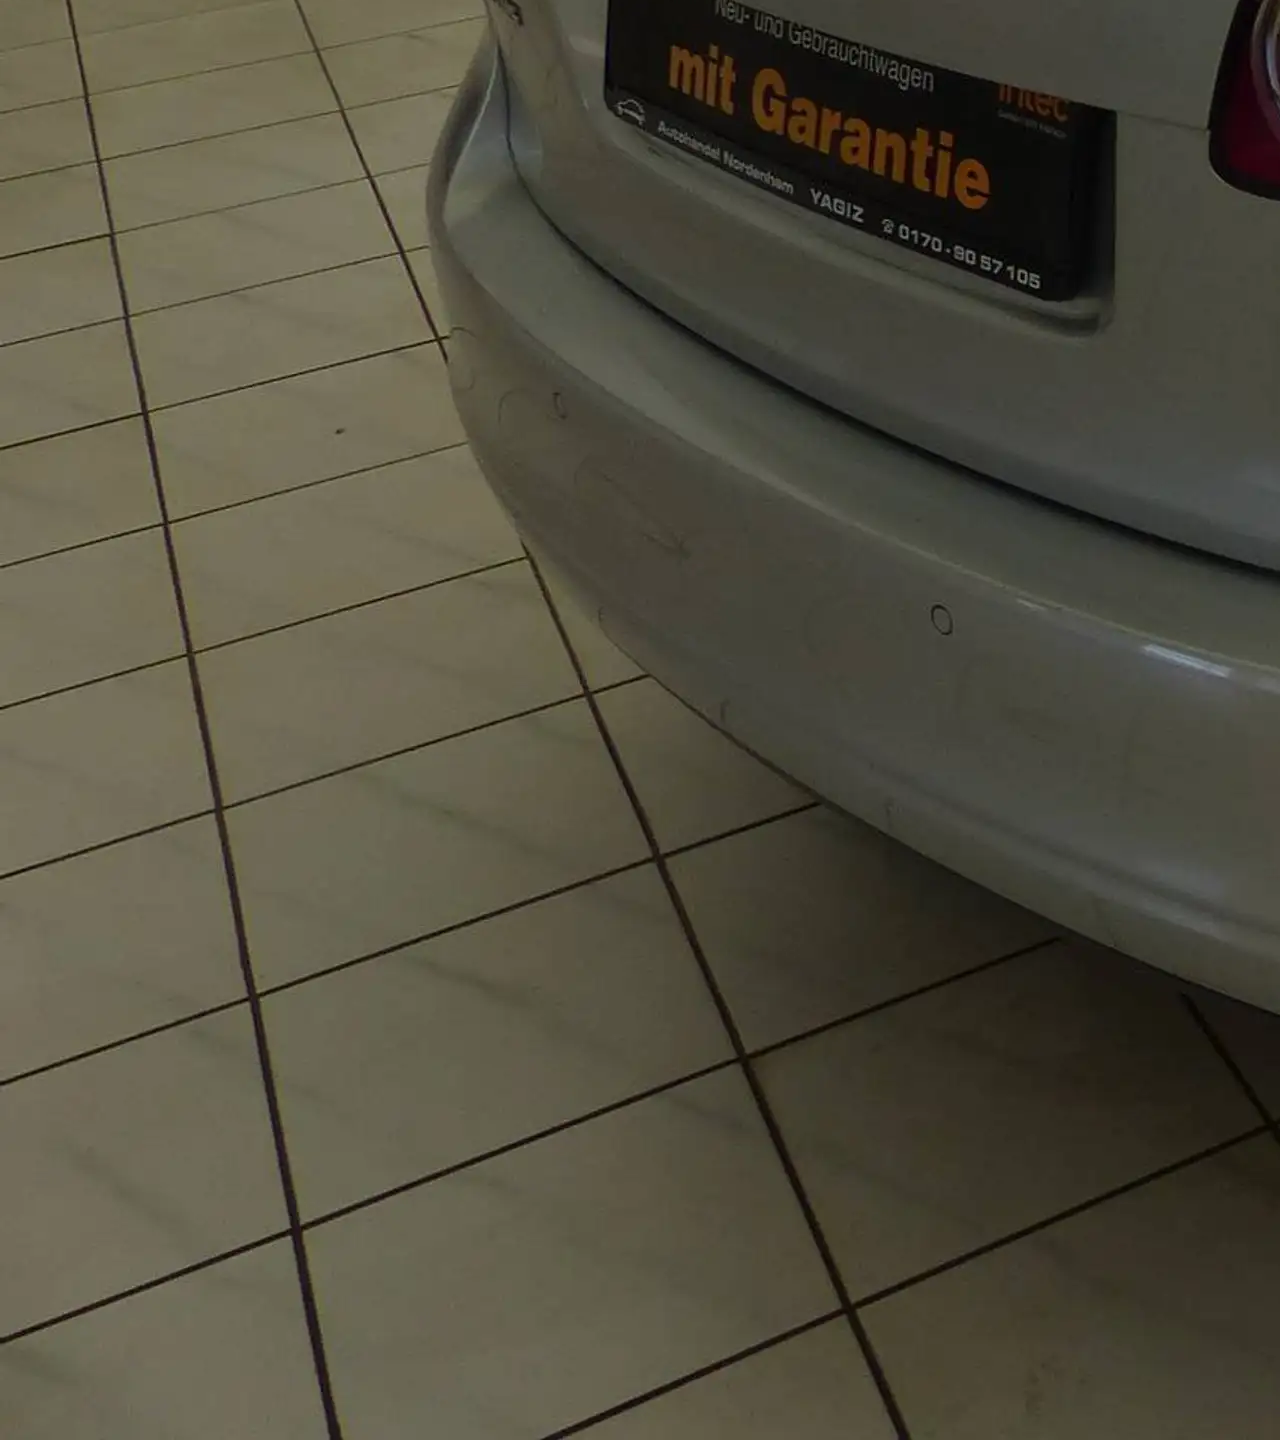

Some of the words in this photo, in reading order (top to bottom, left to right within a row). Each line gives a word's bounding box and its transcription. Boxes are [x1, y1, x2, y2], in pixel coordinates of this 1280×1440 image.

[788, 19, 936, 93] Gebrauchtwagen
[656, 119, 721, 162] Autohandel
[722, 149, 795, 196] Nordenham
[809, 186, 865, 225] YAGIZ
[667, 40, 738, 116] mit
[751, 66, 993, 211] Garantie
